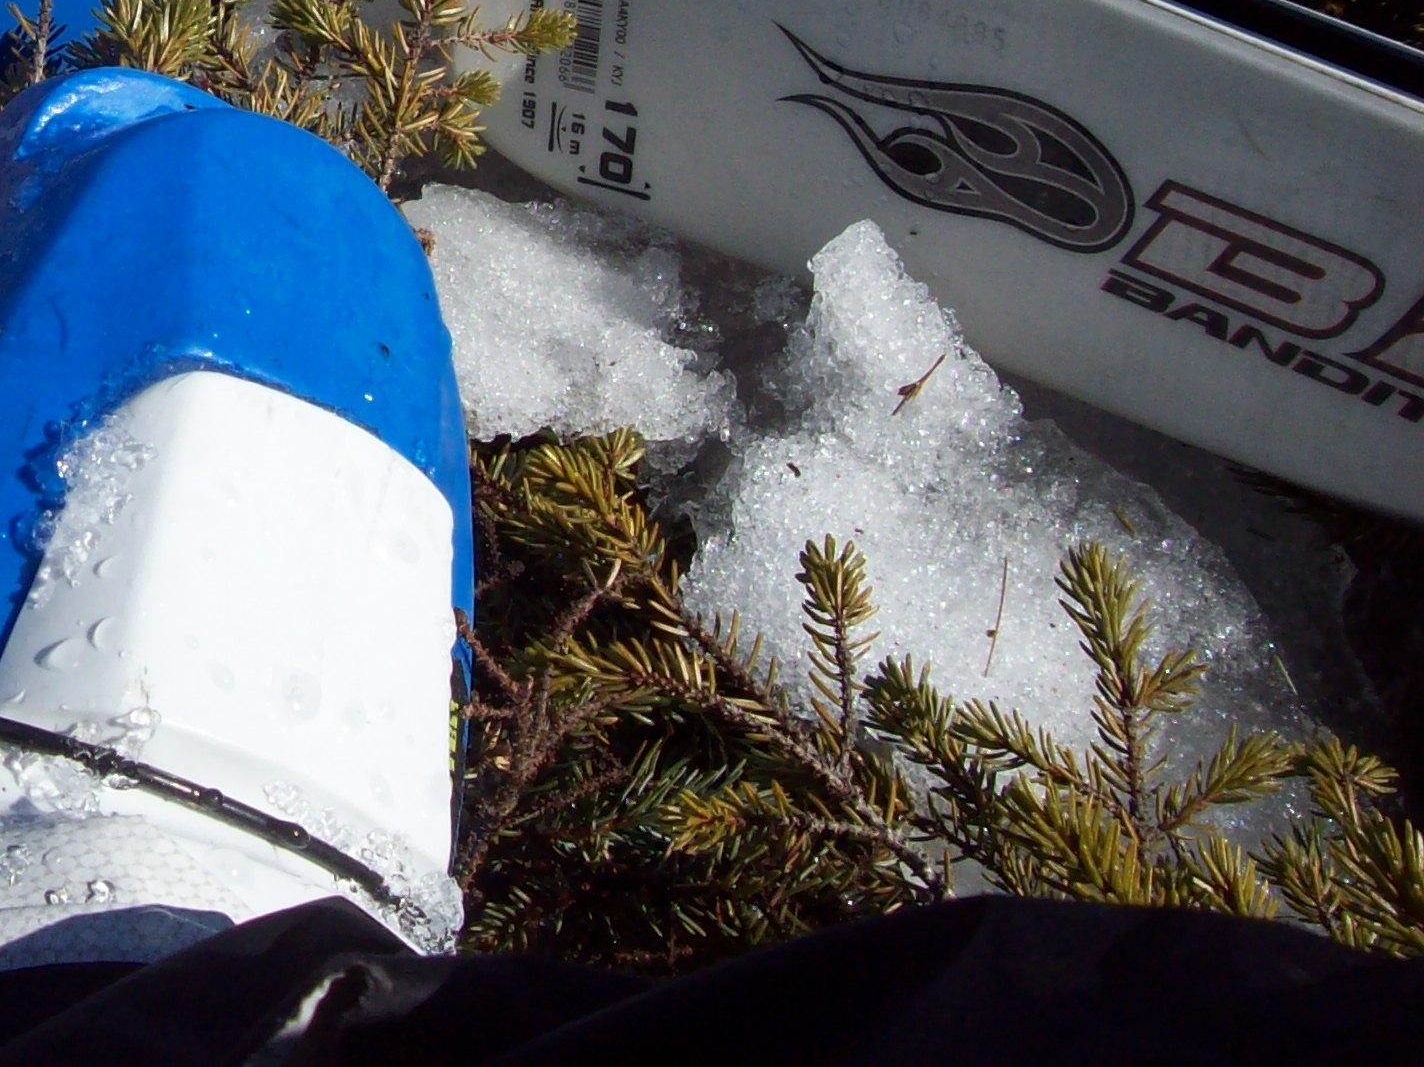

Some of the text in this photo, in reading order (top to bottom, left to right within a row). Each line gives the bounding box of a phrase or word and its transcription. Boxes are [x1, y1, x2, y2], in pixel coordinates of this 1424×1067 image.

[521, 91, 536, 130] 1907
[569, 113, 586, 155] 16 m
[599, 99, 638, 185] 170
